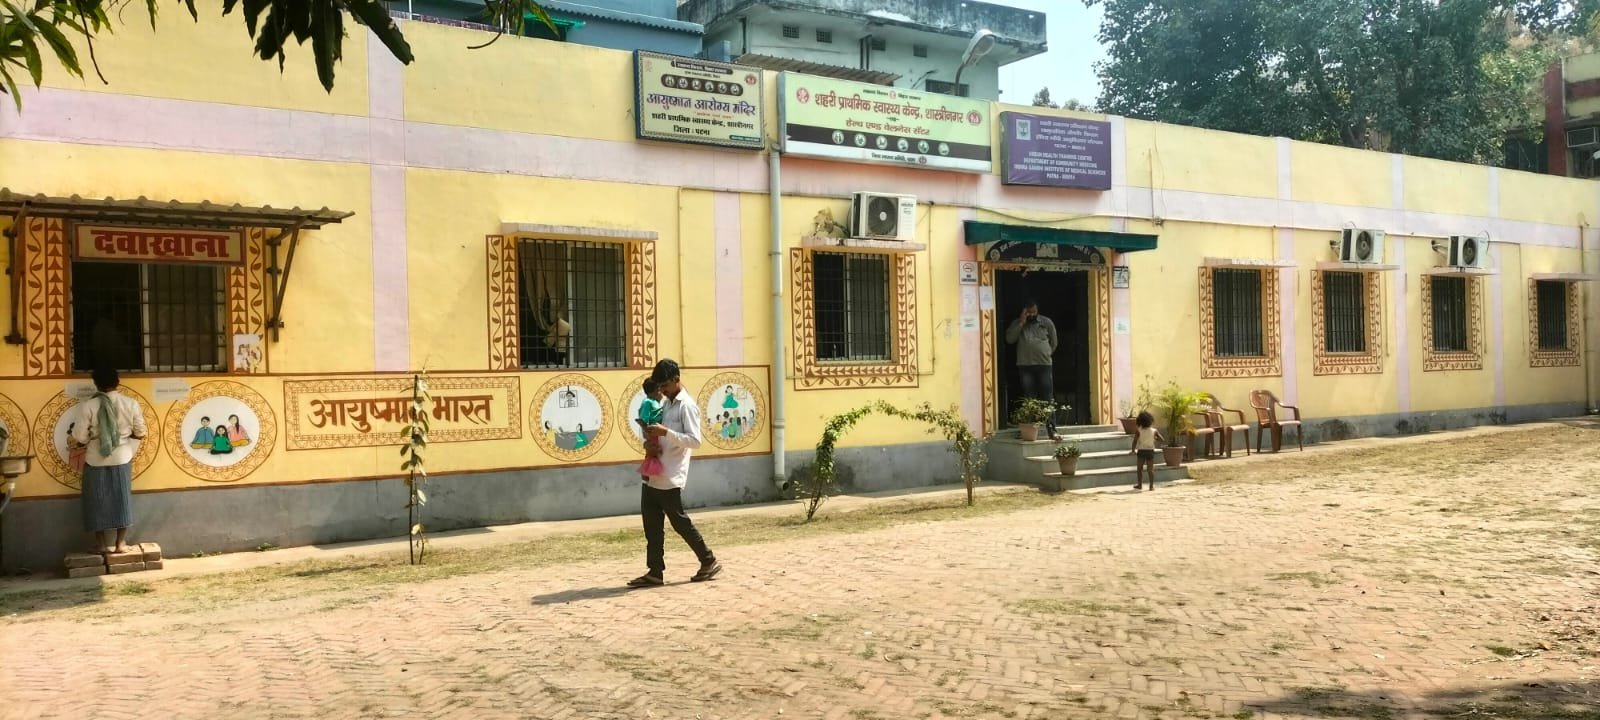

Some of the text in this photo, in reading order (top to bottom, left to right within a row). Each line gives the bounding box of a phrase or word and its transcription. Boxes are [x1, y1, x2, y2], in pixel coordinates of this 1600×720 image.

[646, 93, 692, 111] आयुष्मान
[694, 97, 730, 113] आरोग्य
[733, 100, 756, 116] मंदिर
[815, 90, 836, 108] शहरी
[838, 94, 871, 111] प्राथमिक
[925, 106, 964, 123] शास्त्रीनगर
[90, 229, 230, 258] दवाखाना
[431, 394, 494, 425] भारत
